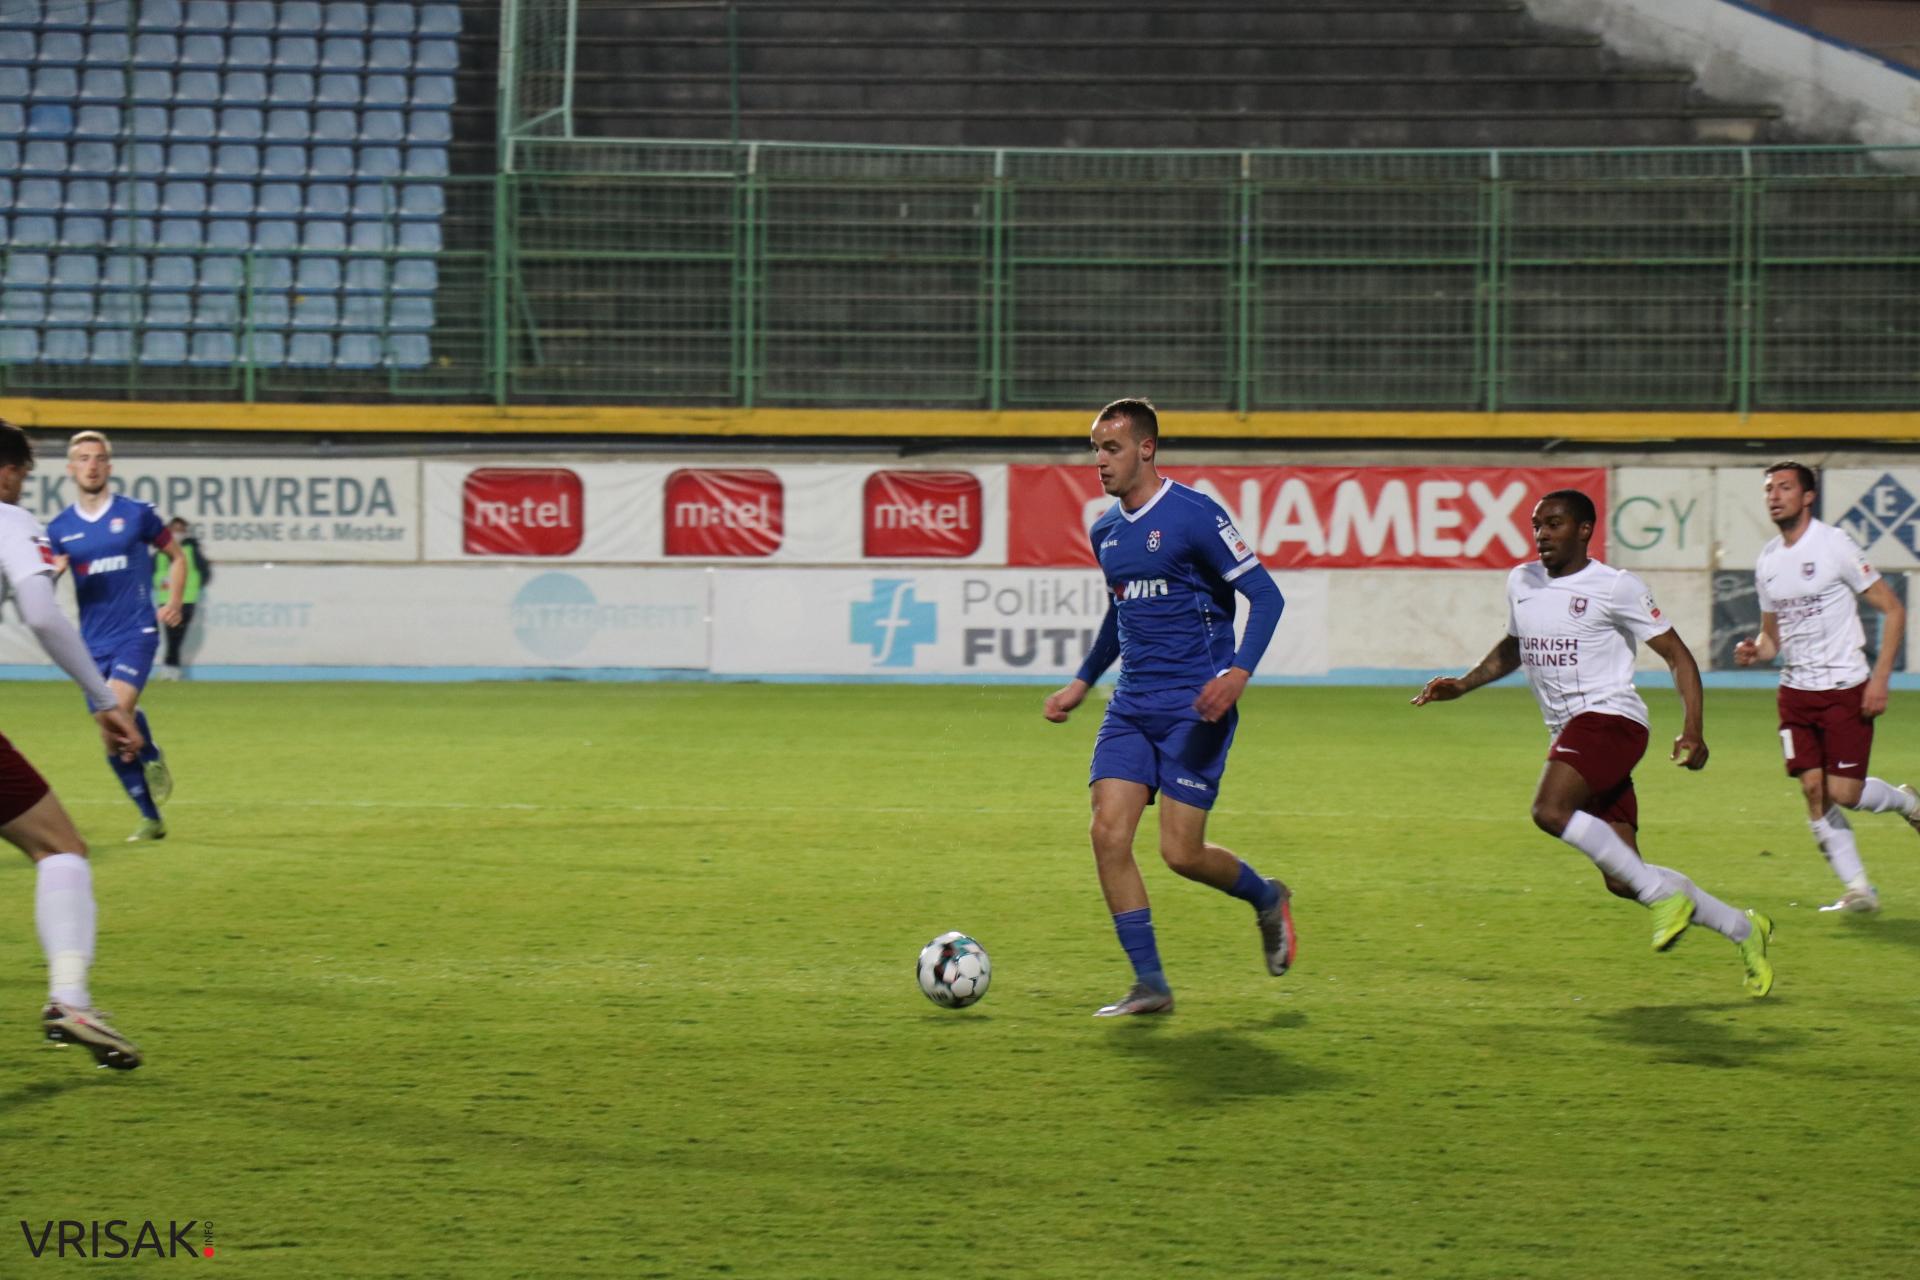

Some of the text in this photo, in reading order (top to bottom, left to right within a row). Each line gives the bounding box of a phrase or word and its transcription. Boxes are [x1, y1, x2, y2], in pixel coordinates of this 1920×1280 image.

[475, 493, 571, 528] m:tel
[675, 493, 769, 529] m:tel
[874, 495, 970, 530] m:tel
[1612, 496, 1697, 551] GY
[211, 522, 285, 542] BOSNE
[333, 522, 405, 542] Mostar
